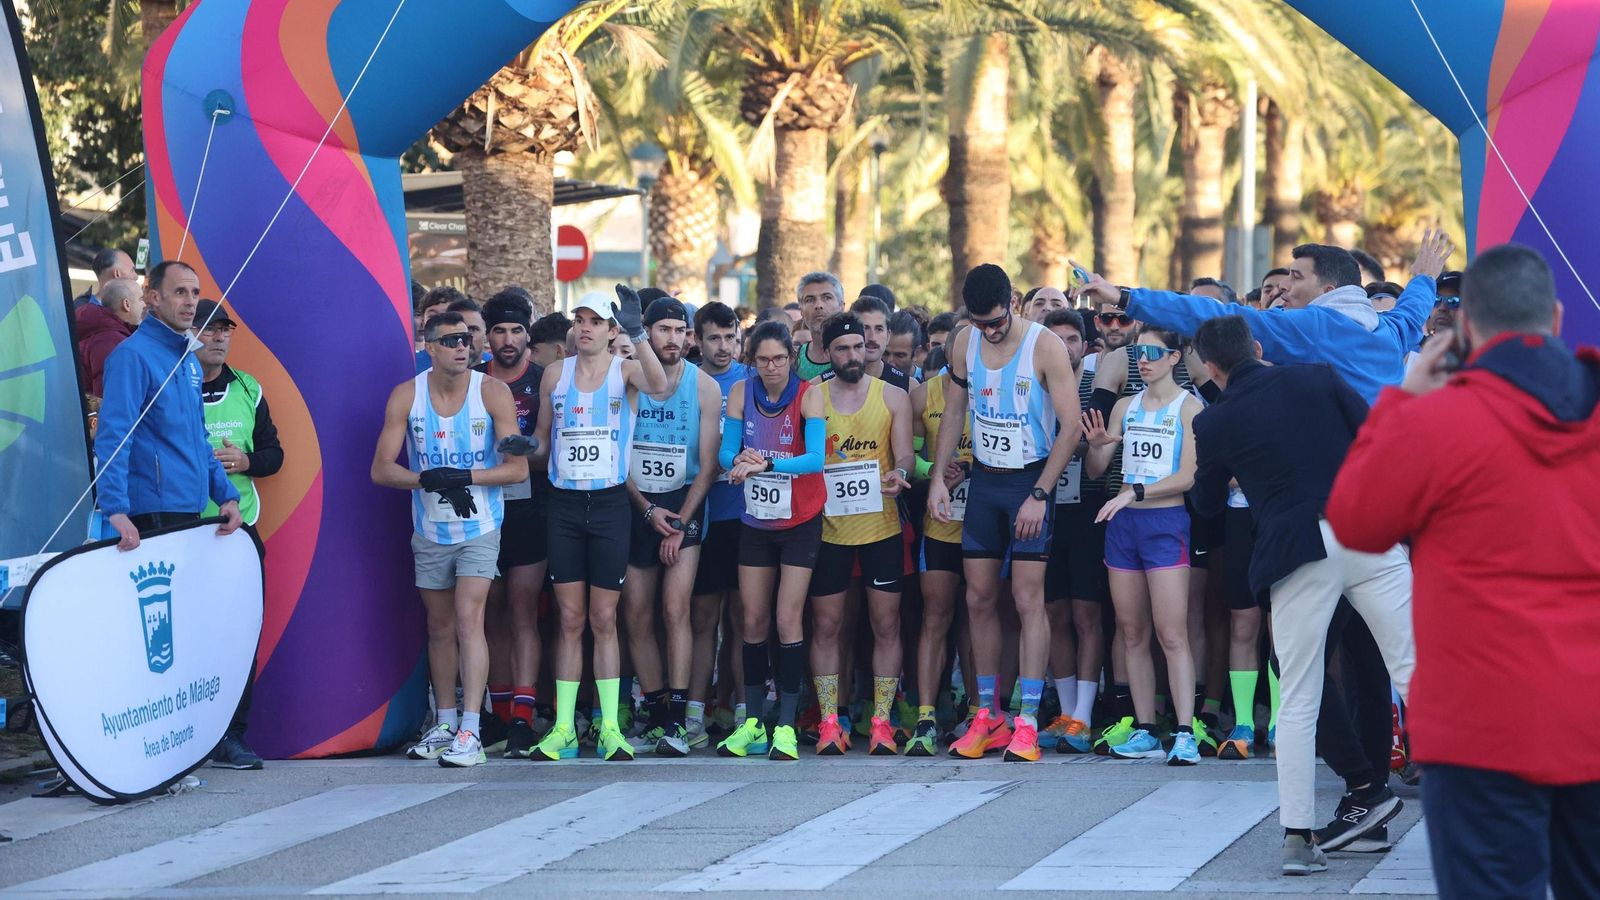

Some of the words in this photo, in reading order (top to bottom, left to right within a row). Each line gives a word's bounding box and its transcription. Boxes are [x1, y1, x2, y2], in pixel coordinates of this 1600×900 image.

[429, 222, 447, 230] Clear
[204, 421, 243, 430] undación
[208, 428, 233, 438] nicaja
[840, 435, 879, 451] Álora
[981, 432, 1011, 452] 573
[1131, 440, 1162, 460] 190
[567, 445, 600, 462] 309
[641, 459, 675, 478] 536
[751, 484, 780, 504] 590
[835, 479, 870, 499] 369
[101, 695, 174, 740] Ayuntamiento
[175, 687, 187, 711] de
[189, 675, 220, 706] Málaga
[143, 736, 161, 759] Área
[161, 734, 170, 752] de
[170, 724, 194, 748] Deporte
